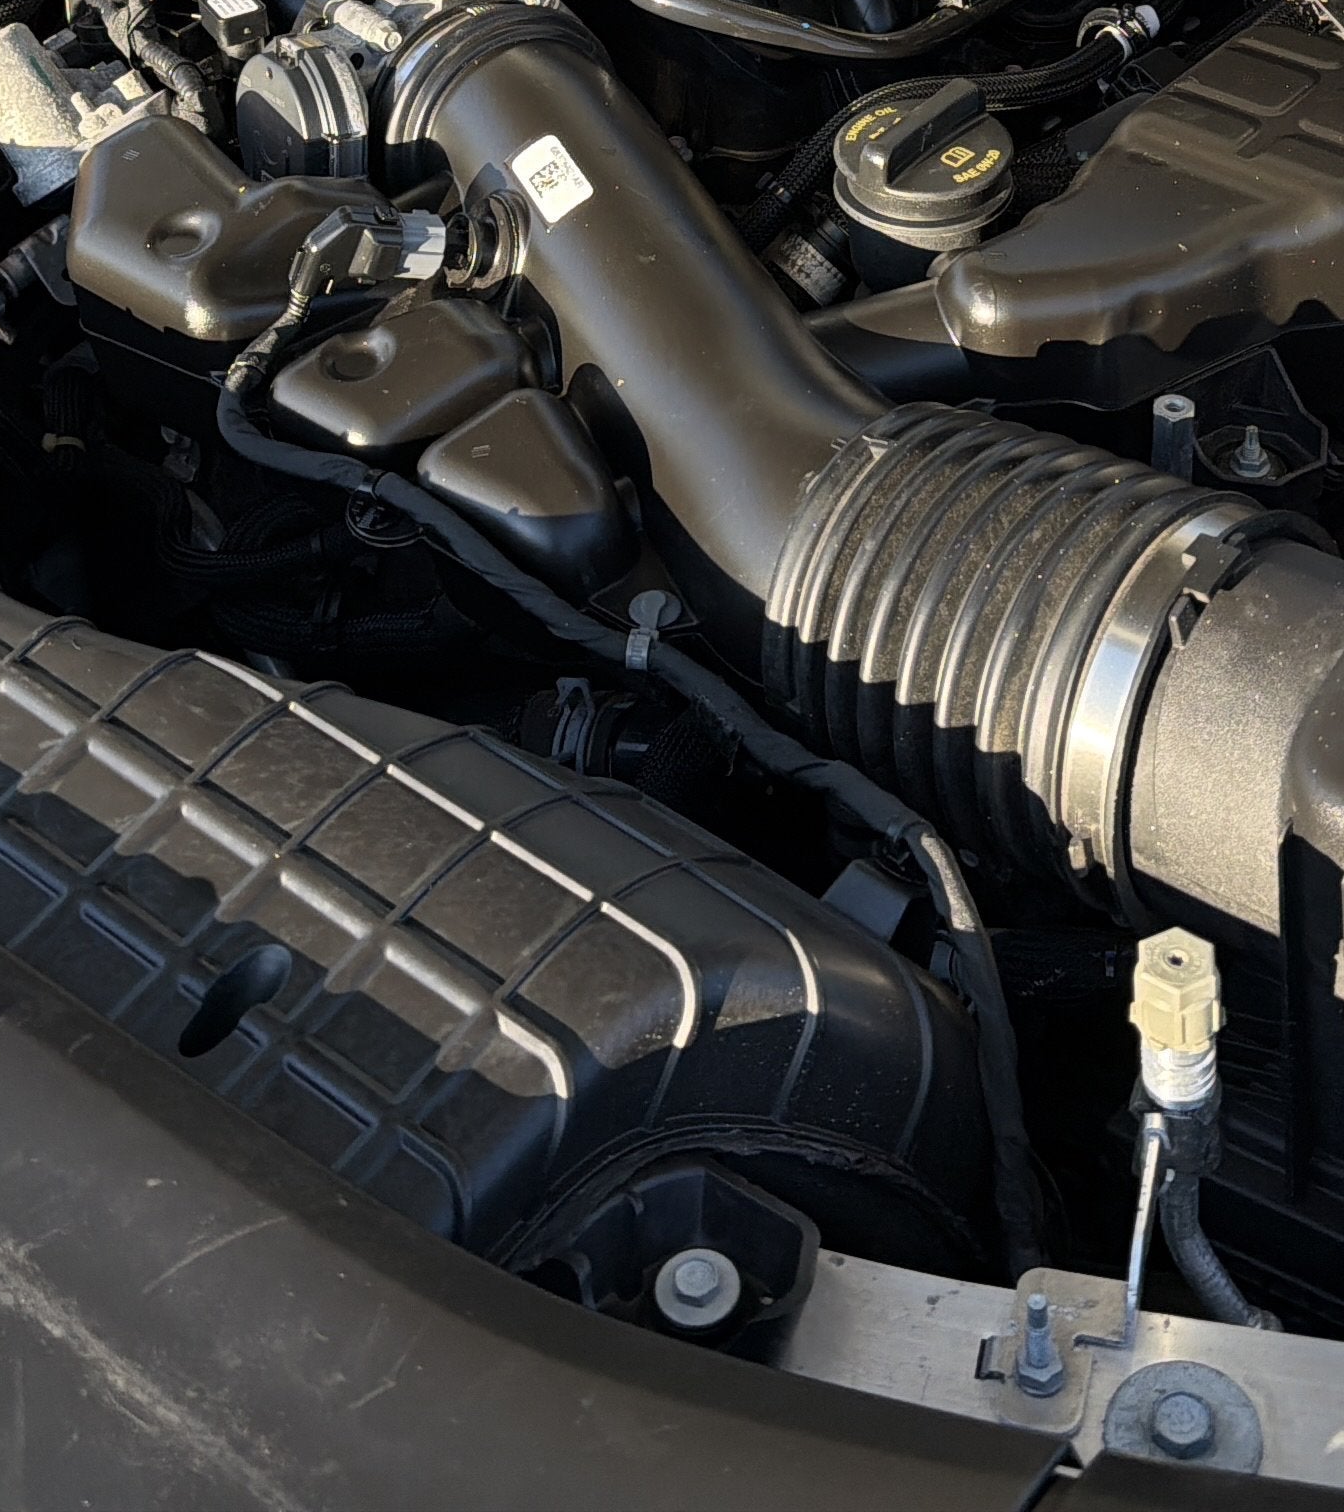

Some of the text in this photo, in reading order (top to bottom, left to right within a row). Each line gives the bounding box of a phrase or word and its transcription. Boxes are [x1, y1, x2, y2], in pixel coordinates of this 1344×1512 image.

[845, 113, 877, 143] ENGINE
[874, 106, 898, 119] OIL
[952, 167, 981, 184] SAE
